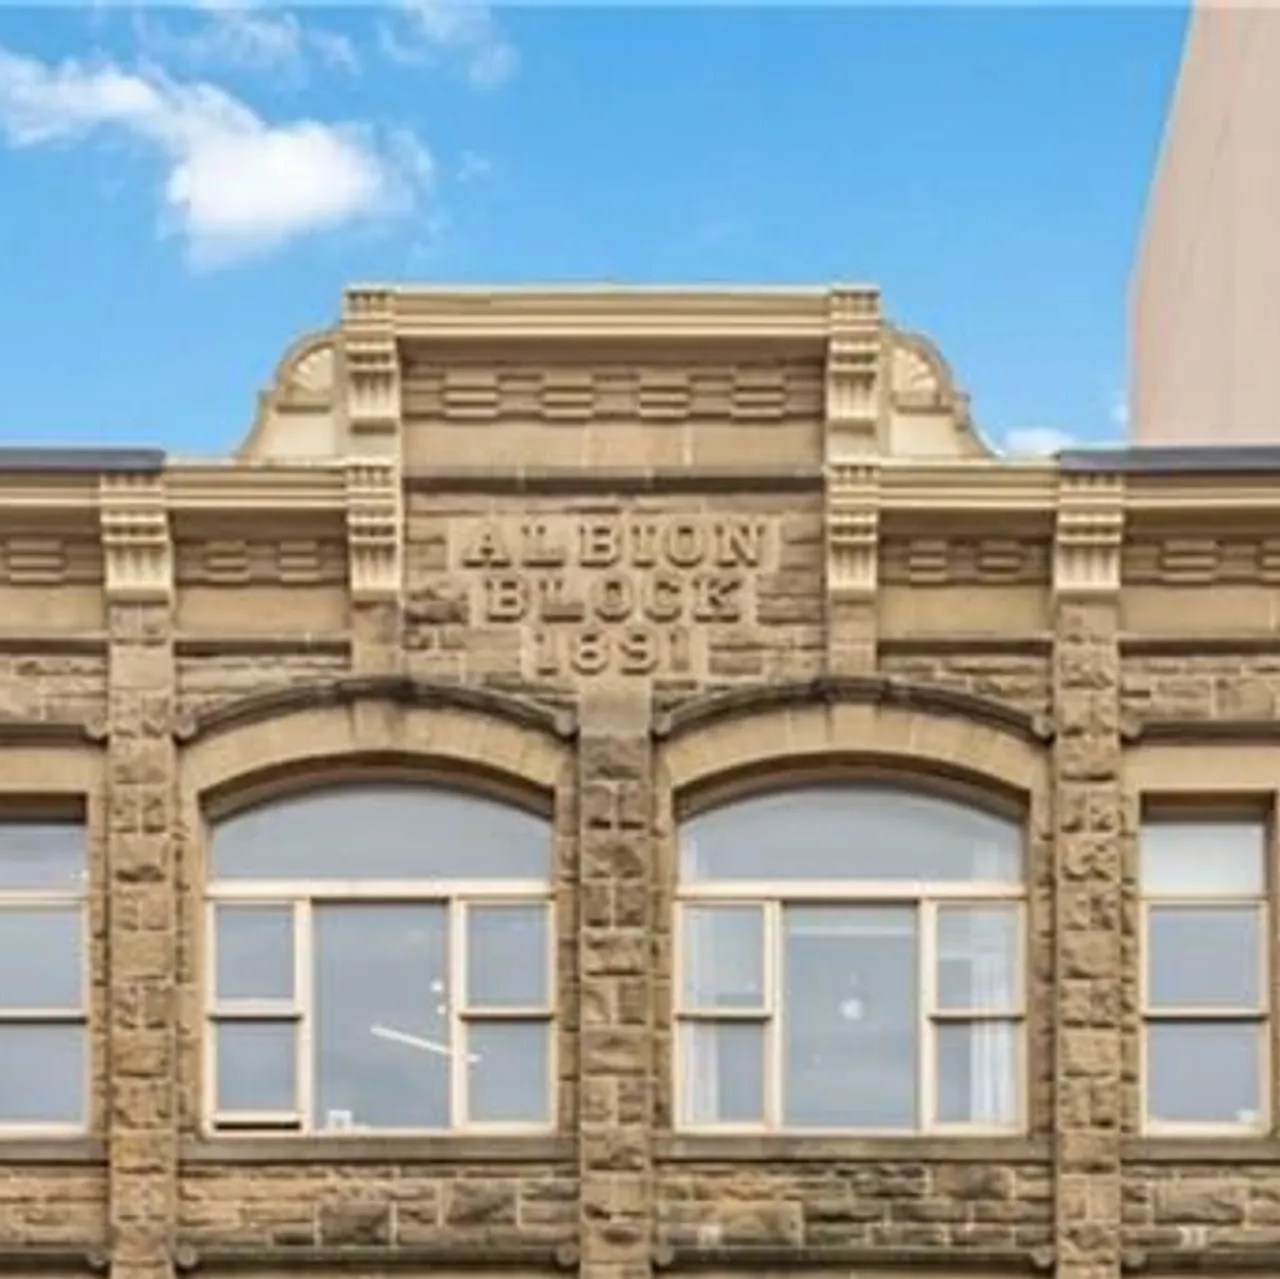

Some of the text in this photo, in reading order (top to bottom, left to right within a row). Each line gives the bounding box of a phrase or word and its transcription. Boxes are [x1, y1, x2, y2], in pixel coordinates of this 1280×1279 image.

[460, 520, 766, 569] ALBION
[482, 574, 745, 623] BLOCK
[530, 627, 692, 676] 1891
